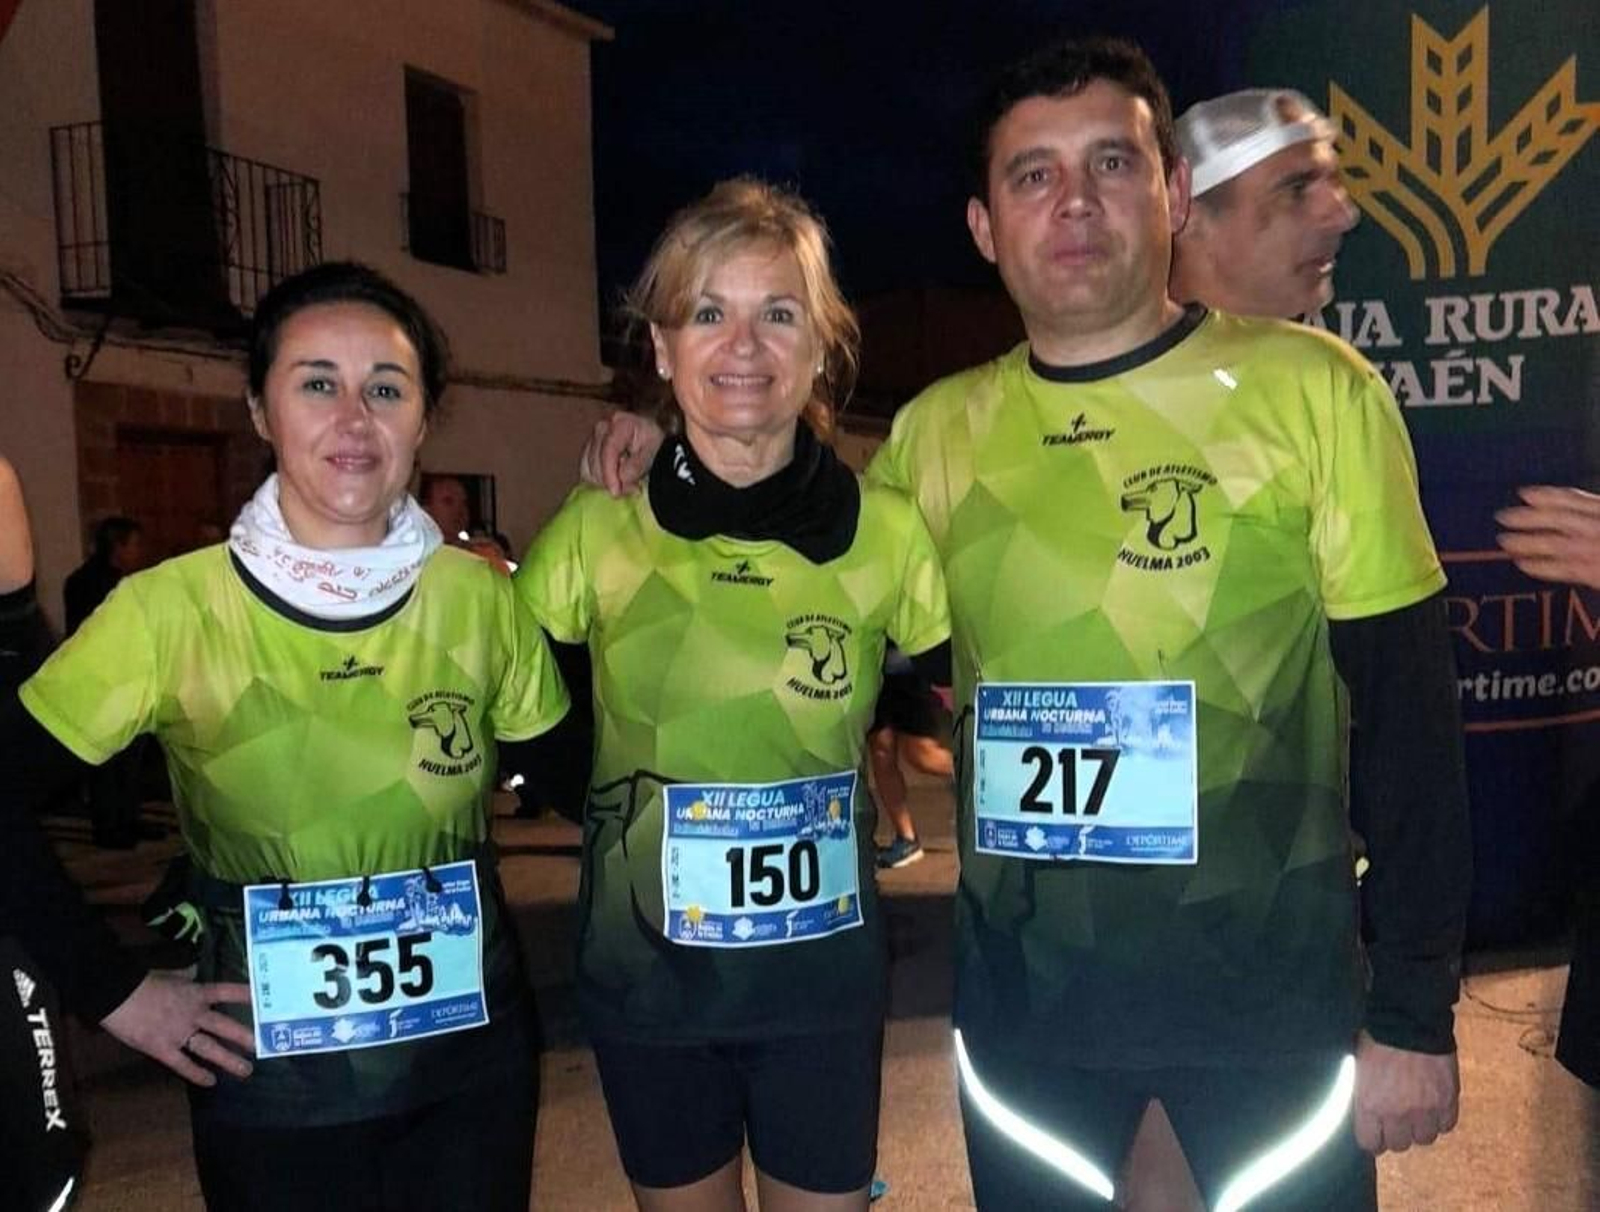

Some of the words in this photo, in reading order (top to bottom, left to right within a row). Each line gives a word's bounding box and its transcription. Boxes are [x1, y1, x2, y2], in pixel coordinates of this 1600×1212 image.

[1424, 284, 1600, 345] RURA
[1376, 350, 1525, 408] AÉN
[1123, 469, 1147, 489] CLUB
[1149, 465, 1162, 477] DE
[1117, 547, 1173, 571] HUELMA
[1176, 546, 1211, 569] 2003
[786, 677, 831, 701] HUELMA
[1002, 690, 1021, 708] XII
[1023, 690, 1078, 708] LEGUA
[984, 707, 1028, 723] URBANA
[1030, 707, 1107, 724] NOCTURNA
[418, 758, 462, 777] HUELMA
[1019, 745, 1121, 816] 217
[701, 789, 726, 808] XII
[728, 788, 785, 808] LEGUA
[676, 804, 731, 822] URANA
[735, 802, 805, 822] NOCTURNA
[725, 839, 820, 909] 150
[311, 932, 434, 1011] 355
[27, 1007, 68, 1132] TERREX
